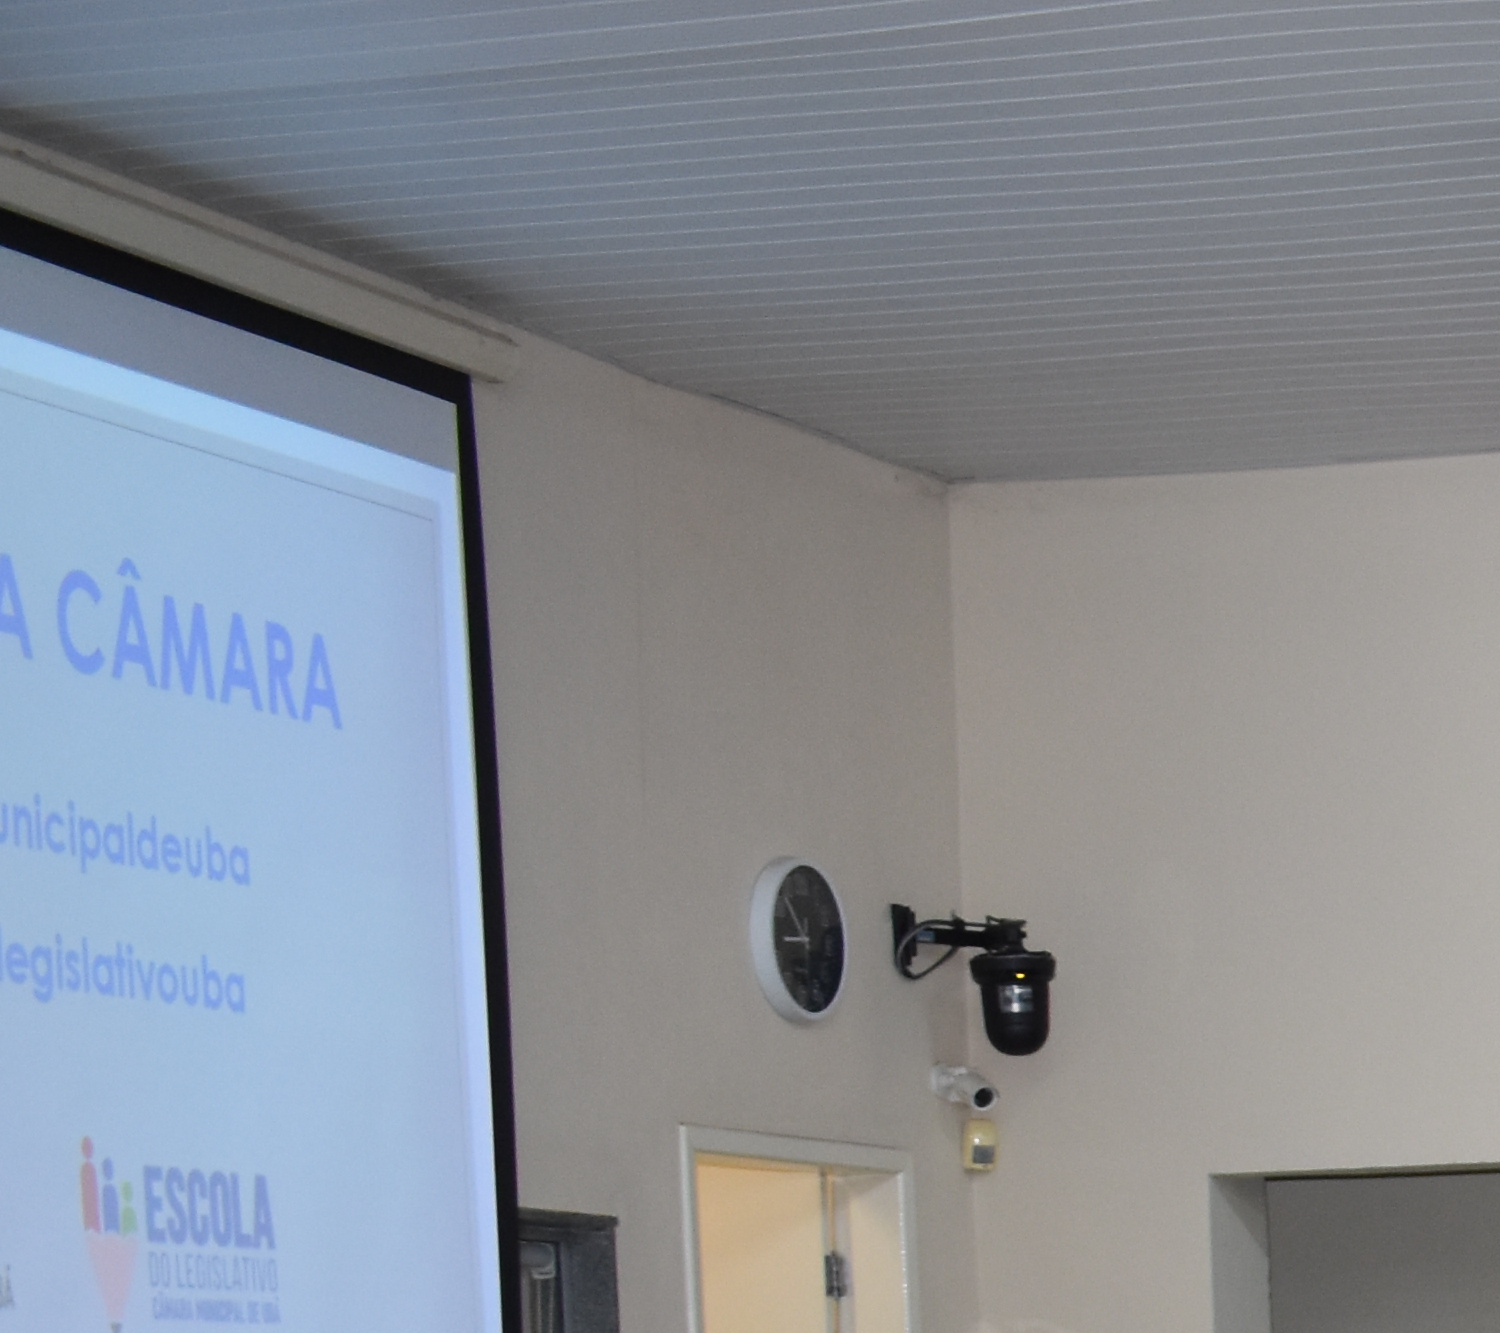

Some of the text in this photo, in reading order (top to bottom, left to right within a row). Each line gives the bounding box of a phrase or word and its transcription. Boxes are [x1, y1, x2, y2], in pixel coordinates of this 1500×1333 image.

[56, 556, 343, 731] CÂMARA
[143, 1164, 277, 1249] ESCOLA
[175, 1253, 279, 1293] LEGISLATIVO
